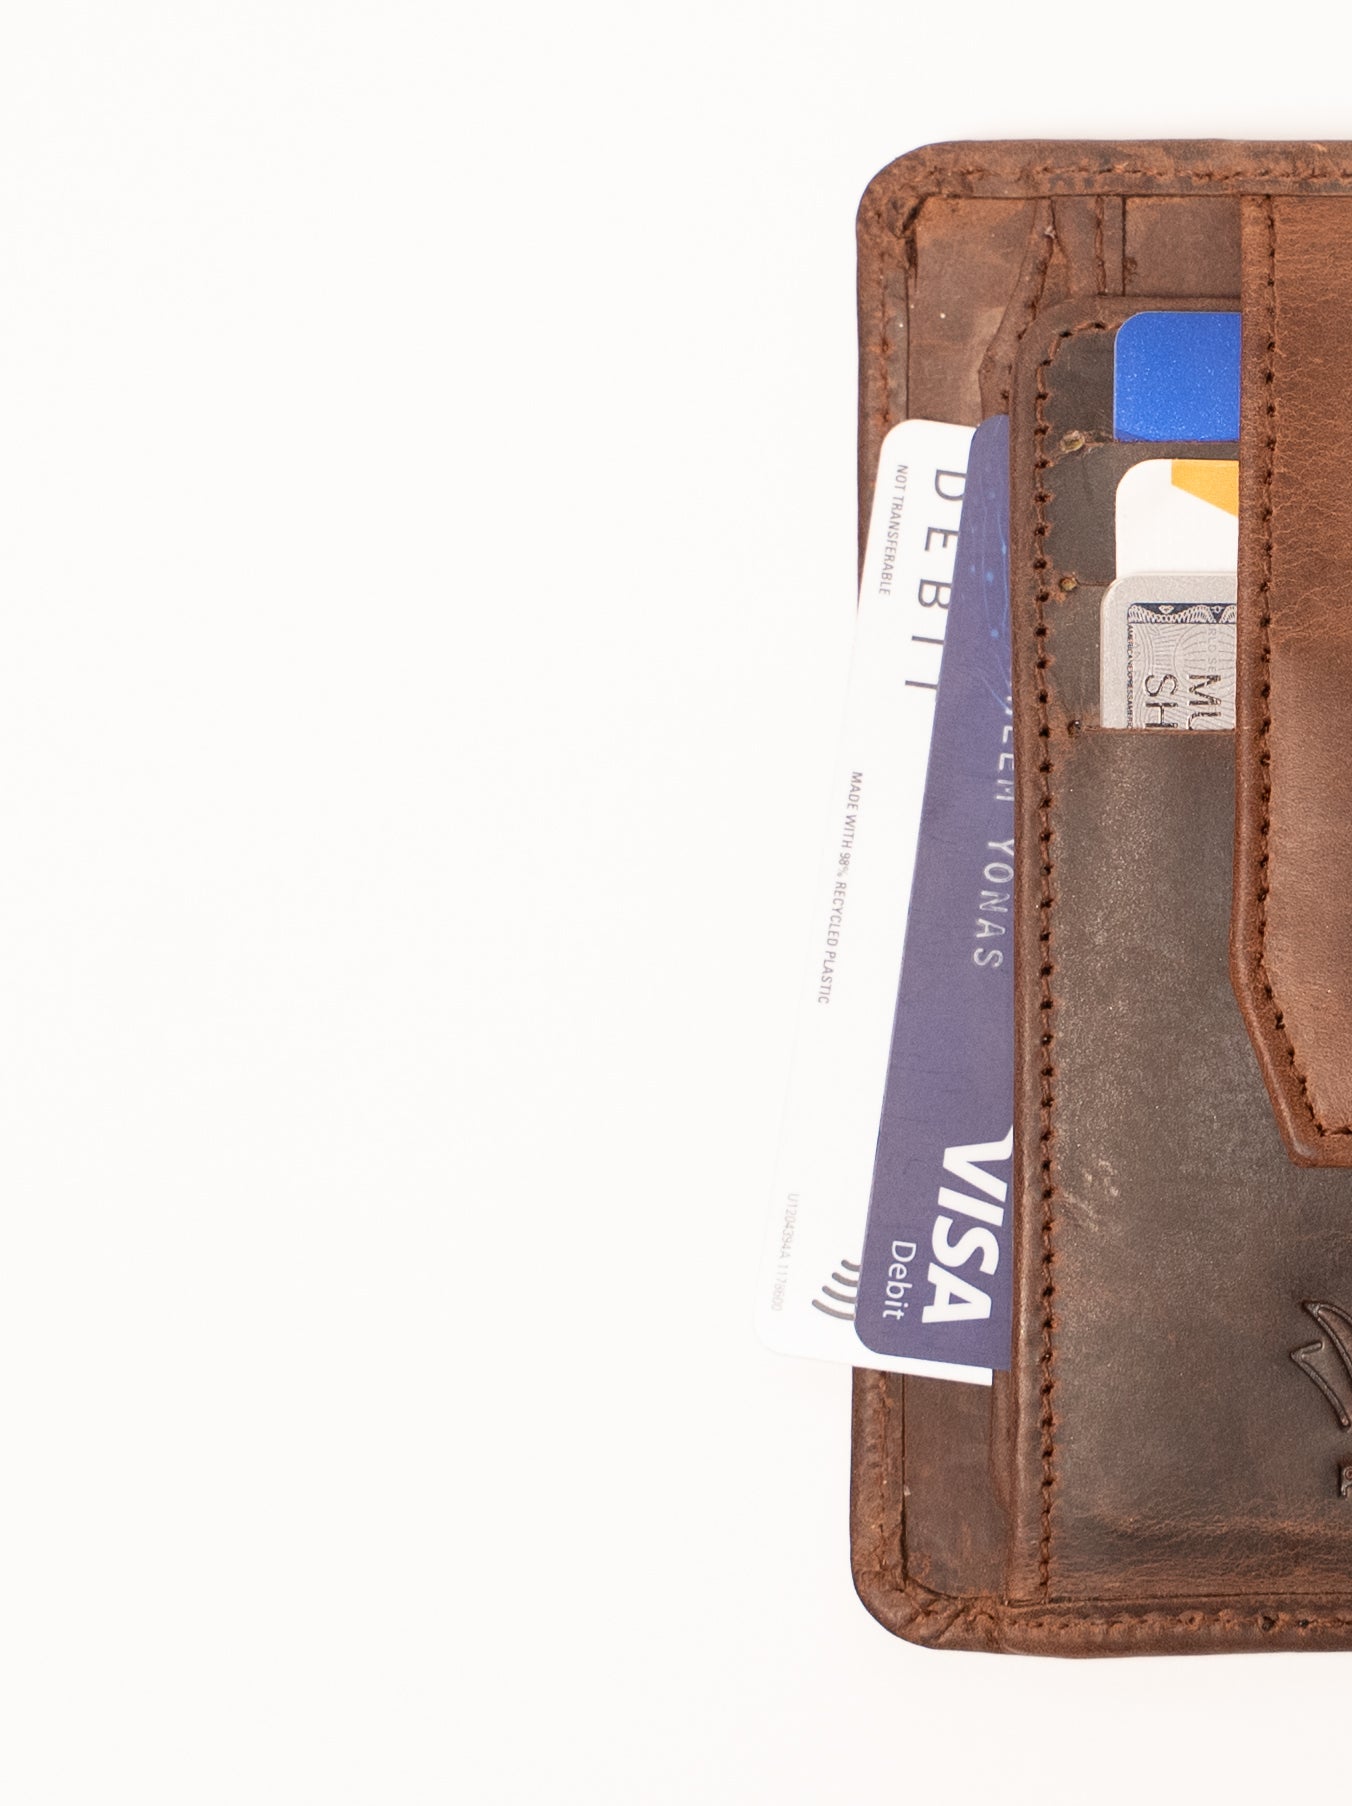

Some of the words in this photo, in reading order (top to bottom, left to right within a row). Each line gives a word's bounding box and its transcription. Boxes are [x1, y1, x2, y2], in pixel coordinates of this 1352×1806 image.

[895, 464, 908, 491] NOT
[878, 493, 905, 595] TRANSFERABLE
[1144, 674, 1179, 729] SH
[847, 770, 863, 811] MADE
[841, 814, 857, 849] WITH
[836, 852, 852, 877] 98%
[826, 881, 847, 947] RECYCLED
[973, 838, 1014, 969] YONAS
[817, 950, 837, 1005] PLASTIC
[921, 1125, 1014, 1324] VISA
[882, 1240, 917, 1320] Debit
